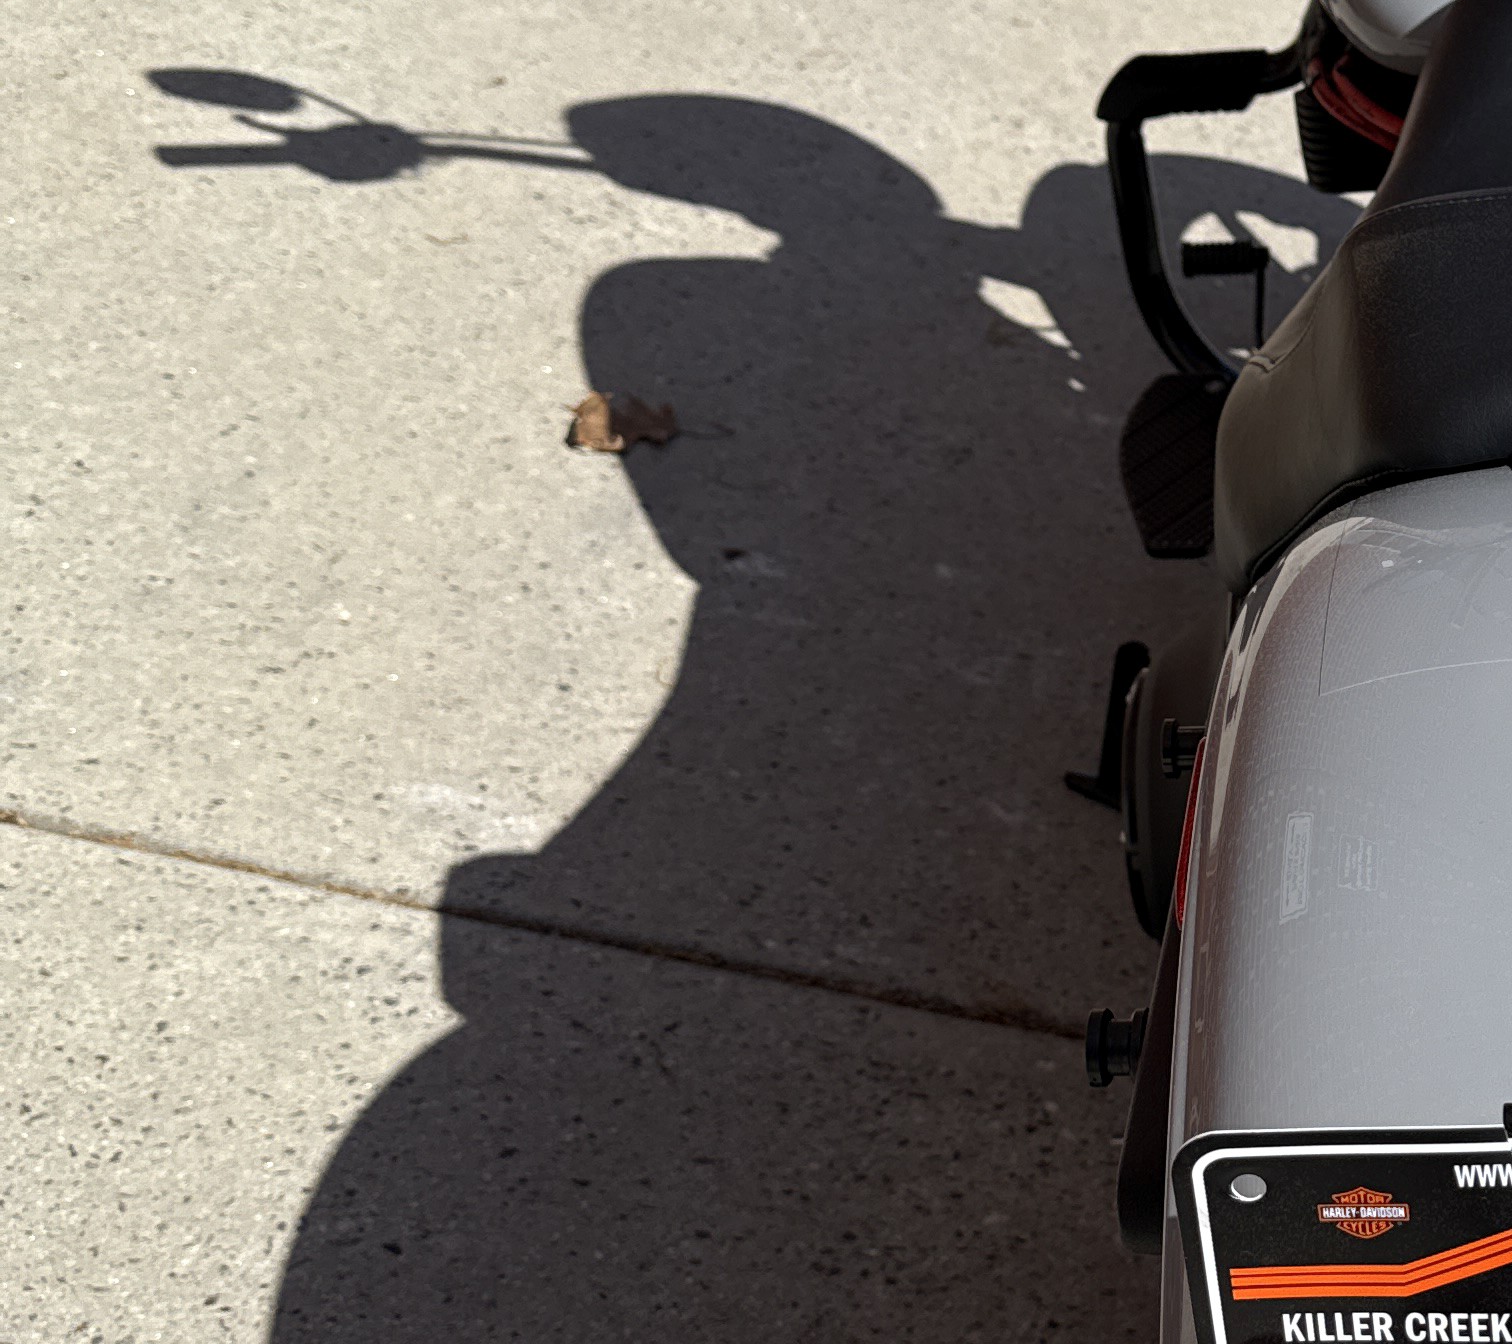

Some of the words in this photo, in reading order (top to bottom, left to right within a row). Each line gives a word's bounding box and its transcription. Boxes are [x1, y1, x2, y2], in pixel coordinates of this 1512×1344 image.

[1341, 1191, 1386, 1205] MOTOR
[1322, 1206, 1406, 1219] HARLEY-DAVIDSON
[1342, 1220, 1388, 1236] CYCLES
[1282, 1312, 1395, 1343] KILLER
